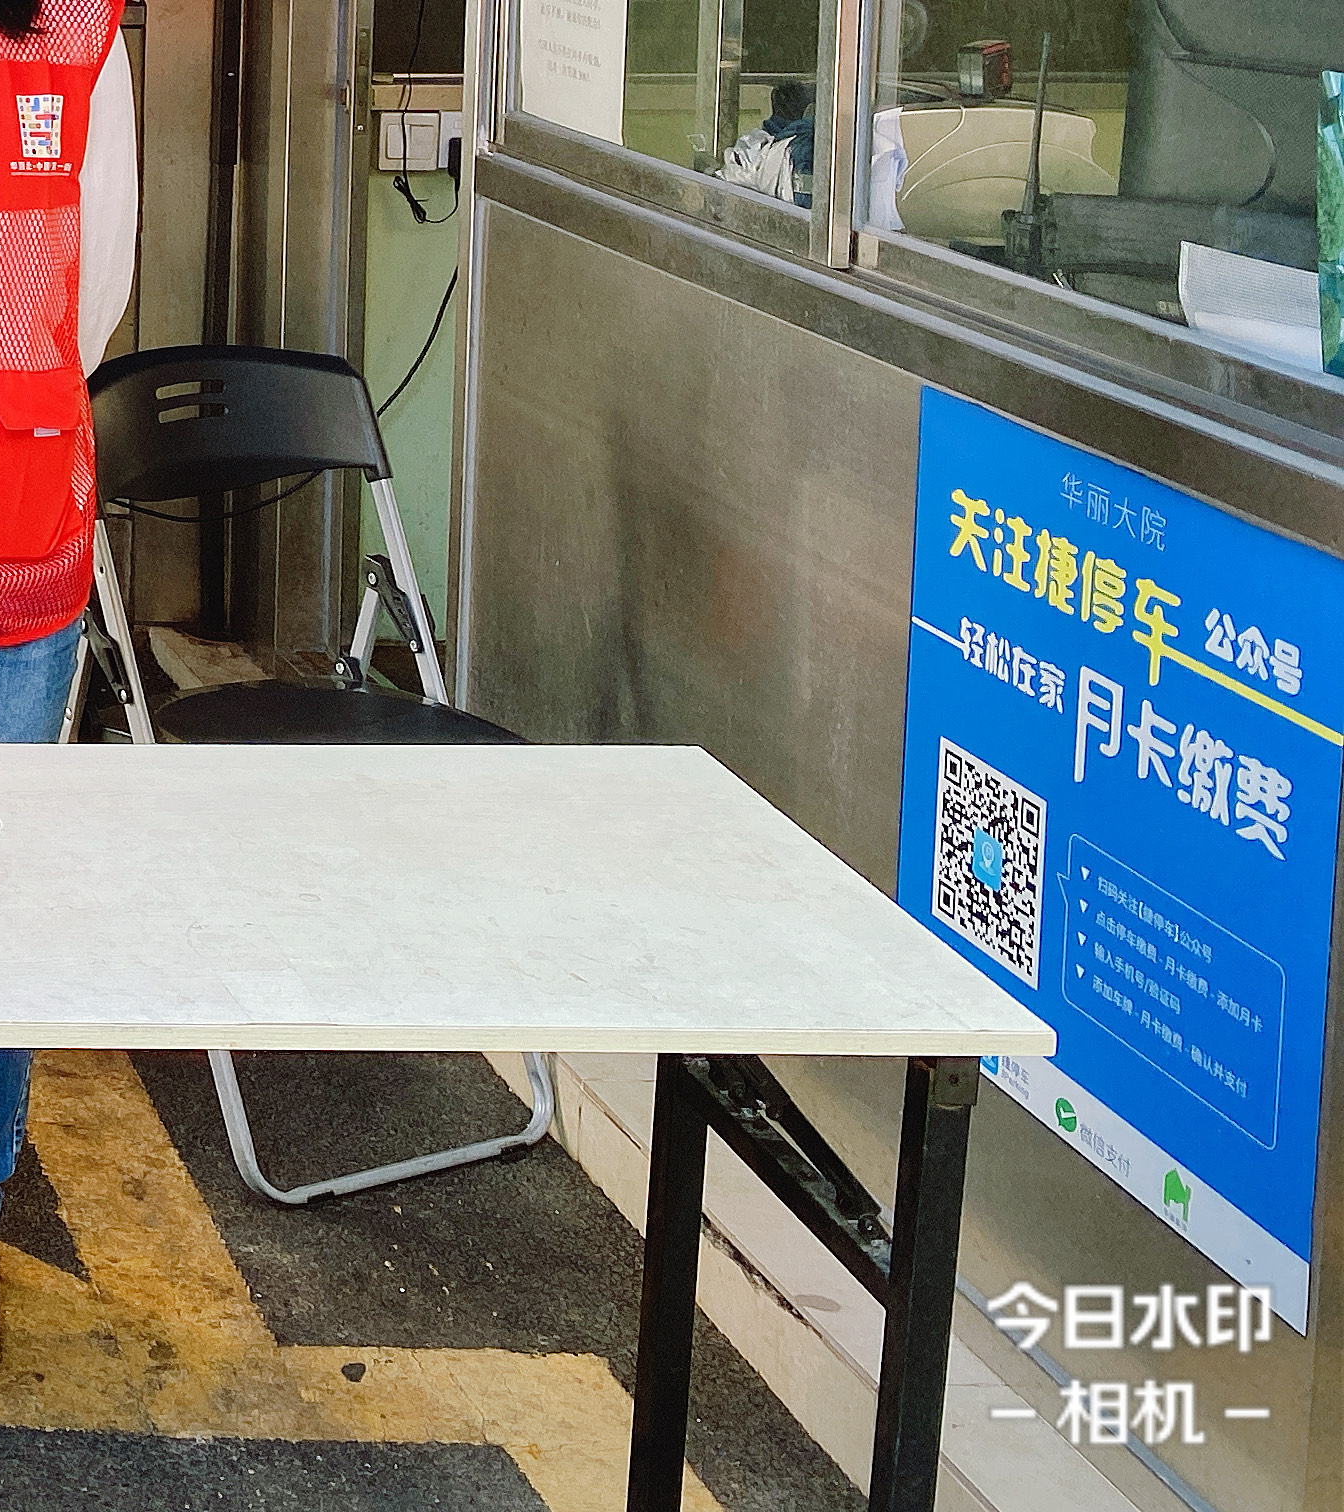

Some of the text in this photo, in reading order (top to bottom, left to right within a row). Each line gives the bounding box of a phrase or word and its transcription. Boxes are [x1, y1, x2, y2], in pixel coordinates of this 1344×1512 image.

[1061, 471, 1168, 552] 华丽大院
[949, 488, 1303, 695] 关注捷停车 公众号
[958, 616, 1293, 862] 轻松在家 月卡缴费
[1080, 1123, 1131, 1177] 微信支付
